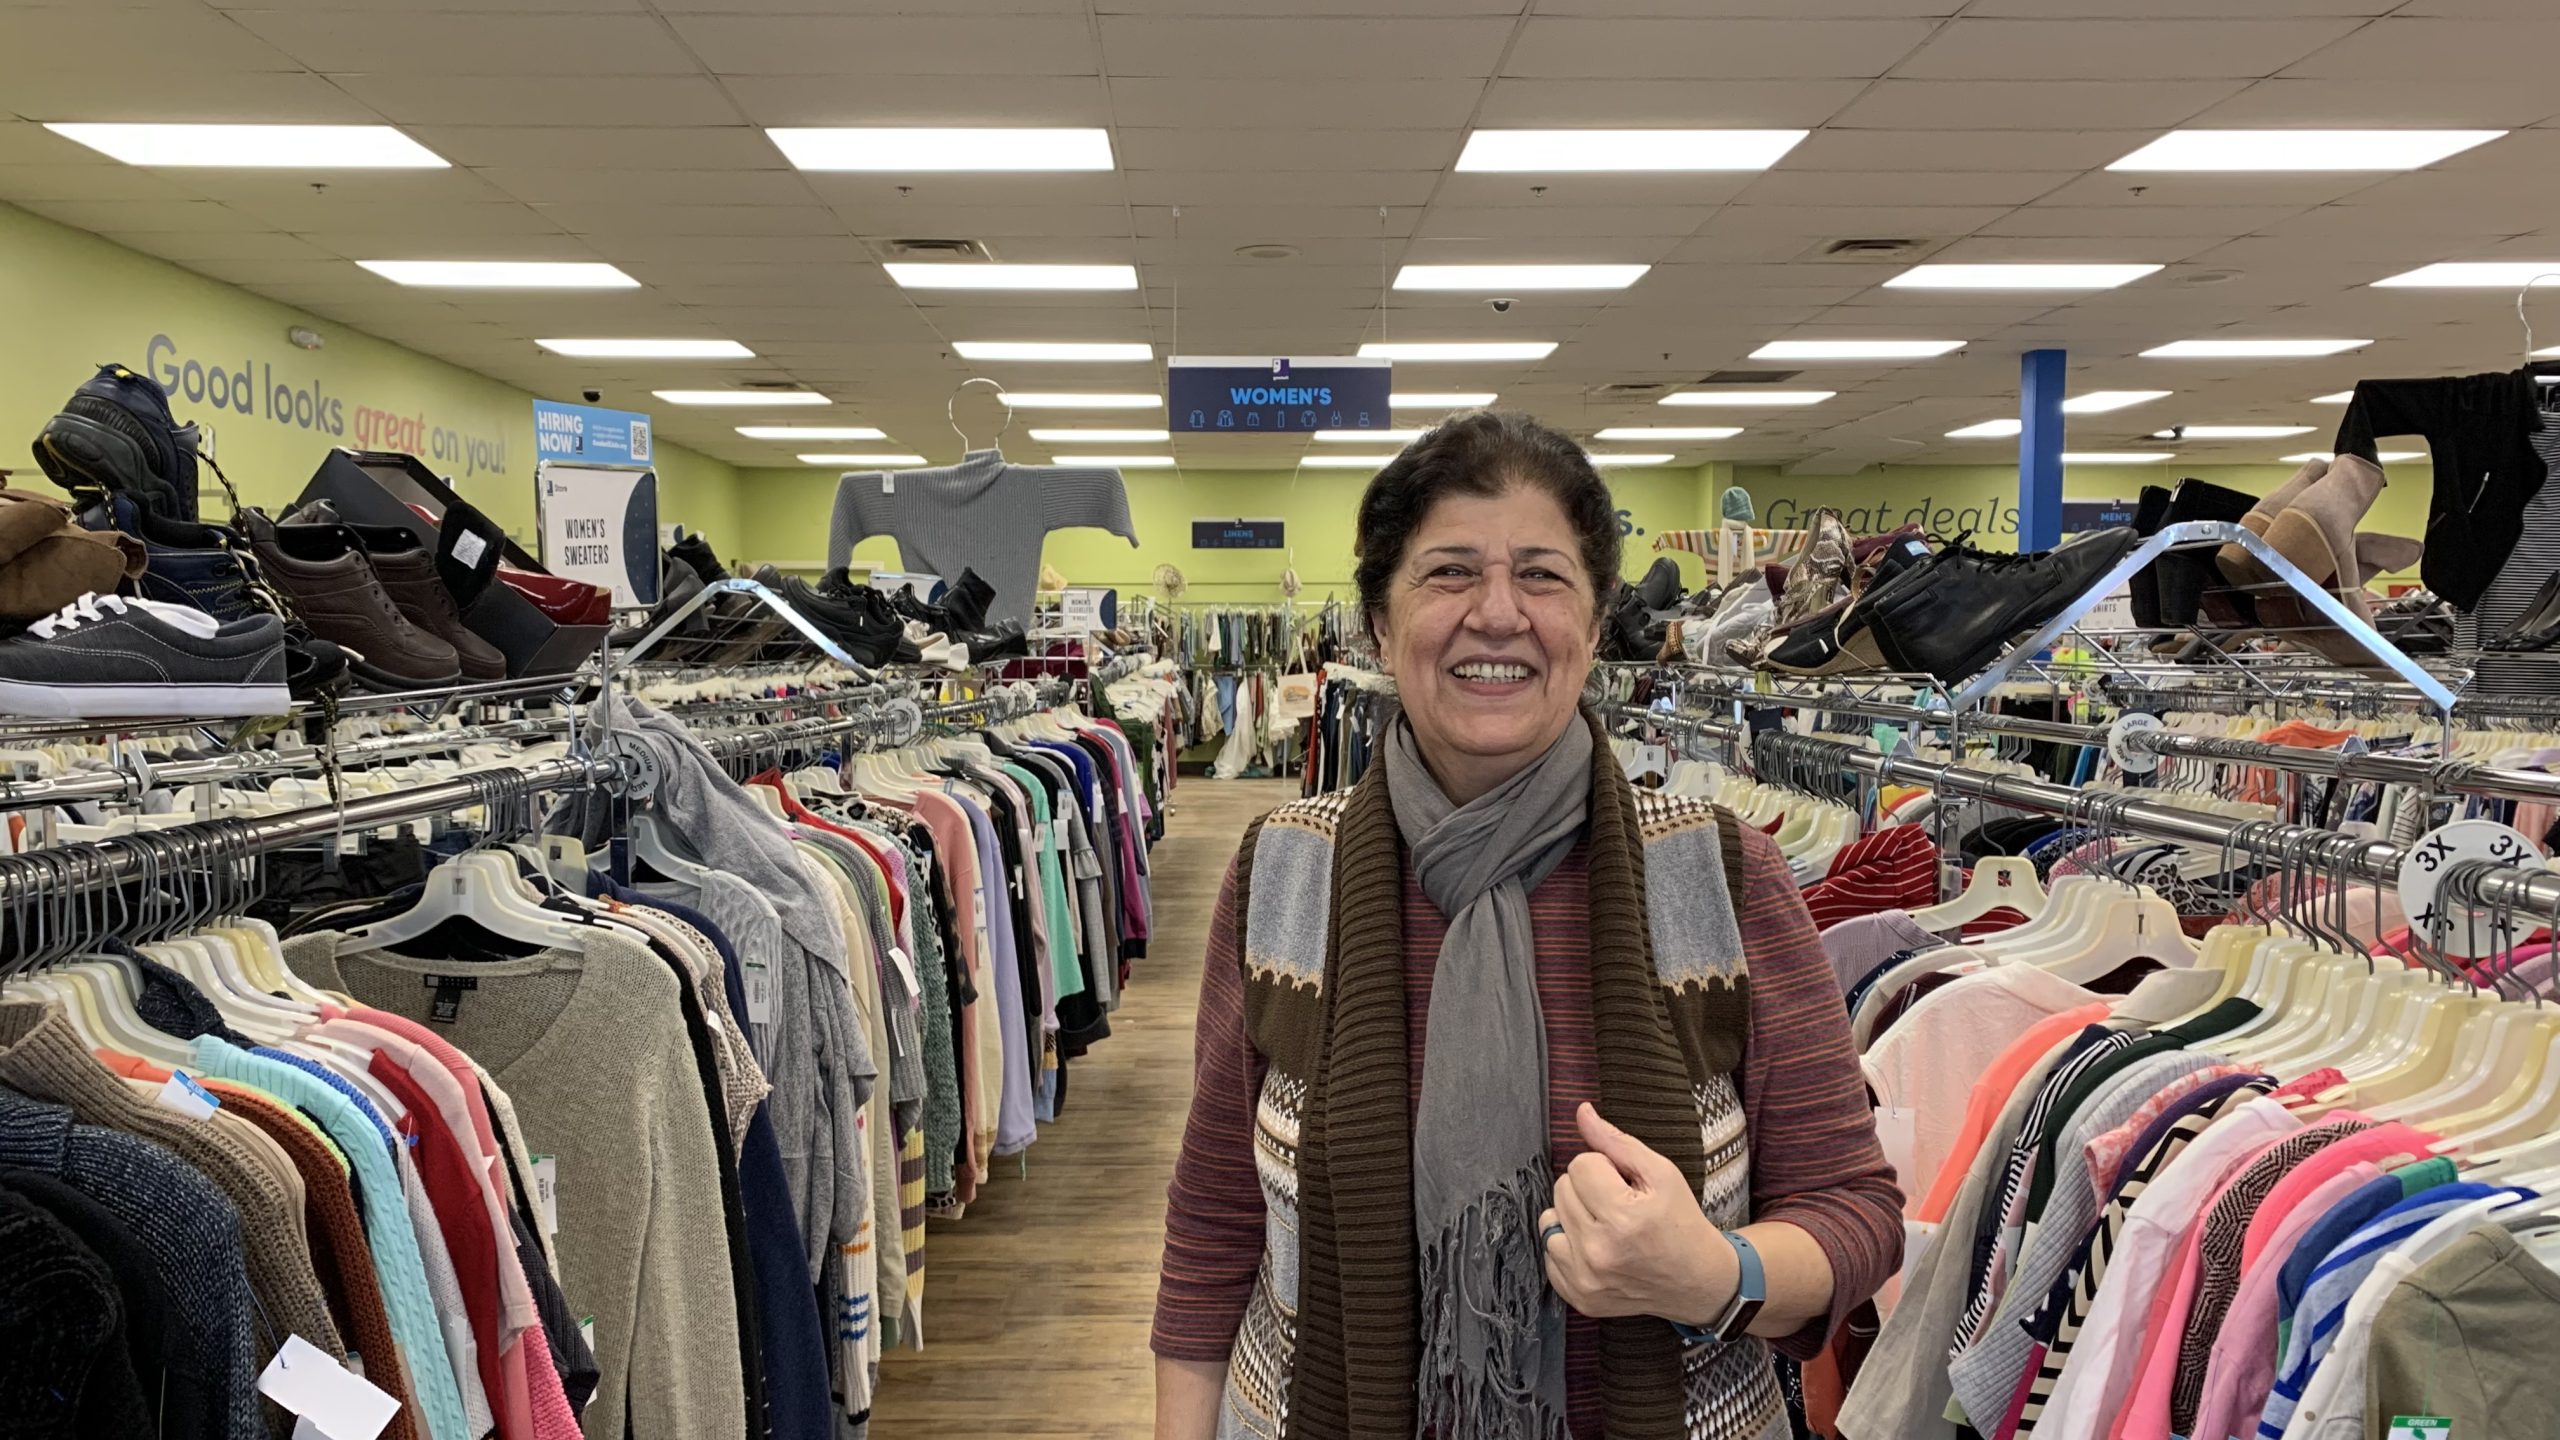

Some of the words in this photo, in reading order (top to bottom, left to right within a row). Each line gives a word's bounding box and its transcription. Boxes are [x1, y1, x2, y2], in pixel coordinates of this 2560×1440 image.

[147, 334, 254, 416] Good
[264, 363, 345, 437] looks
[352, 404, 426, 457] great
[432, 426, 459, 463] on
[465, 433, 506, 477] you!
[1230, 387, 1333, 406] WOMEN'S
[538, 411, 584, 435] HIRING
[540, 432, 573, 454] NOW
[1766, 499, 1892, 534] Grat
[2100, 512, 2132, 522] MEN'S
[564, 518, 606, 539] WOMEN'S
[564, 545, 609, 566] SWEATERS
[2122, 719, 2149, 731] LARGE
[628, 741, 654, 772] MEDIUM
[2415, 834, 2457, 872] 3X
[2489, 834, 2533, 867] 3X
[2407, 1418, 2438, 1427] GREEN
